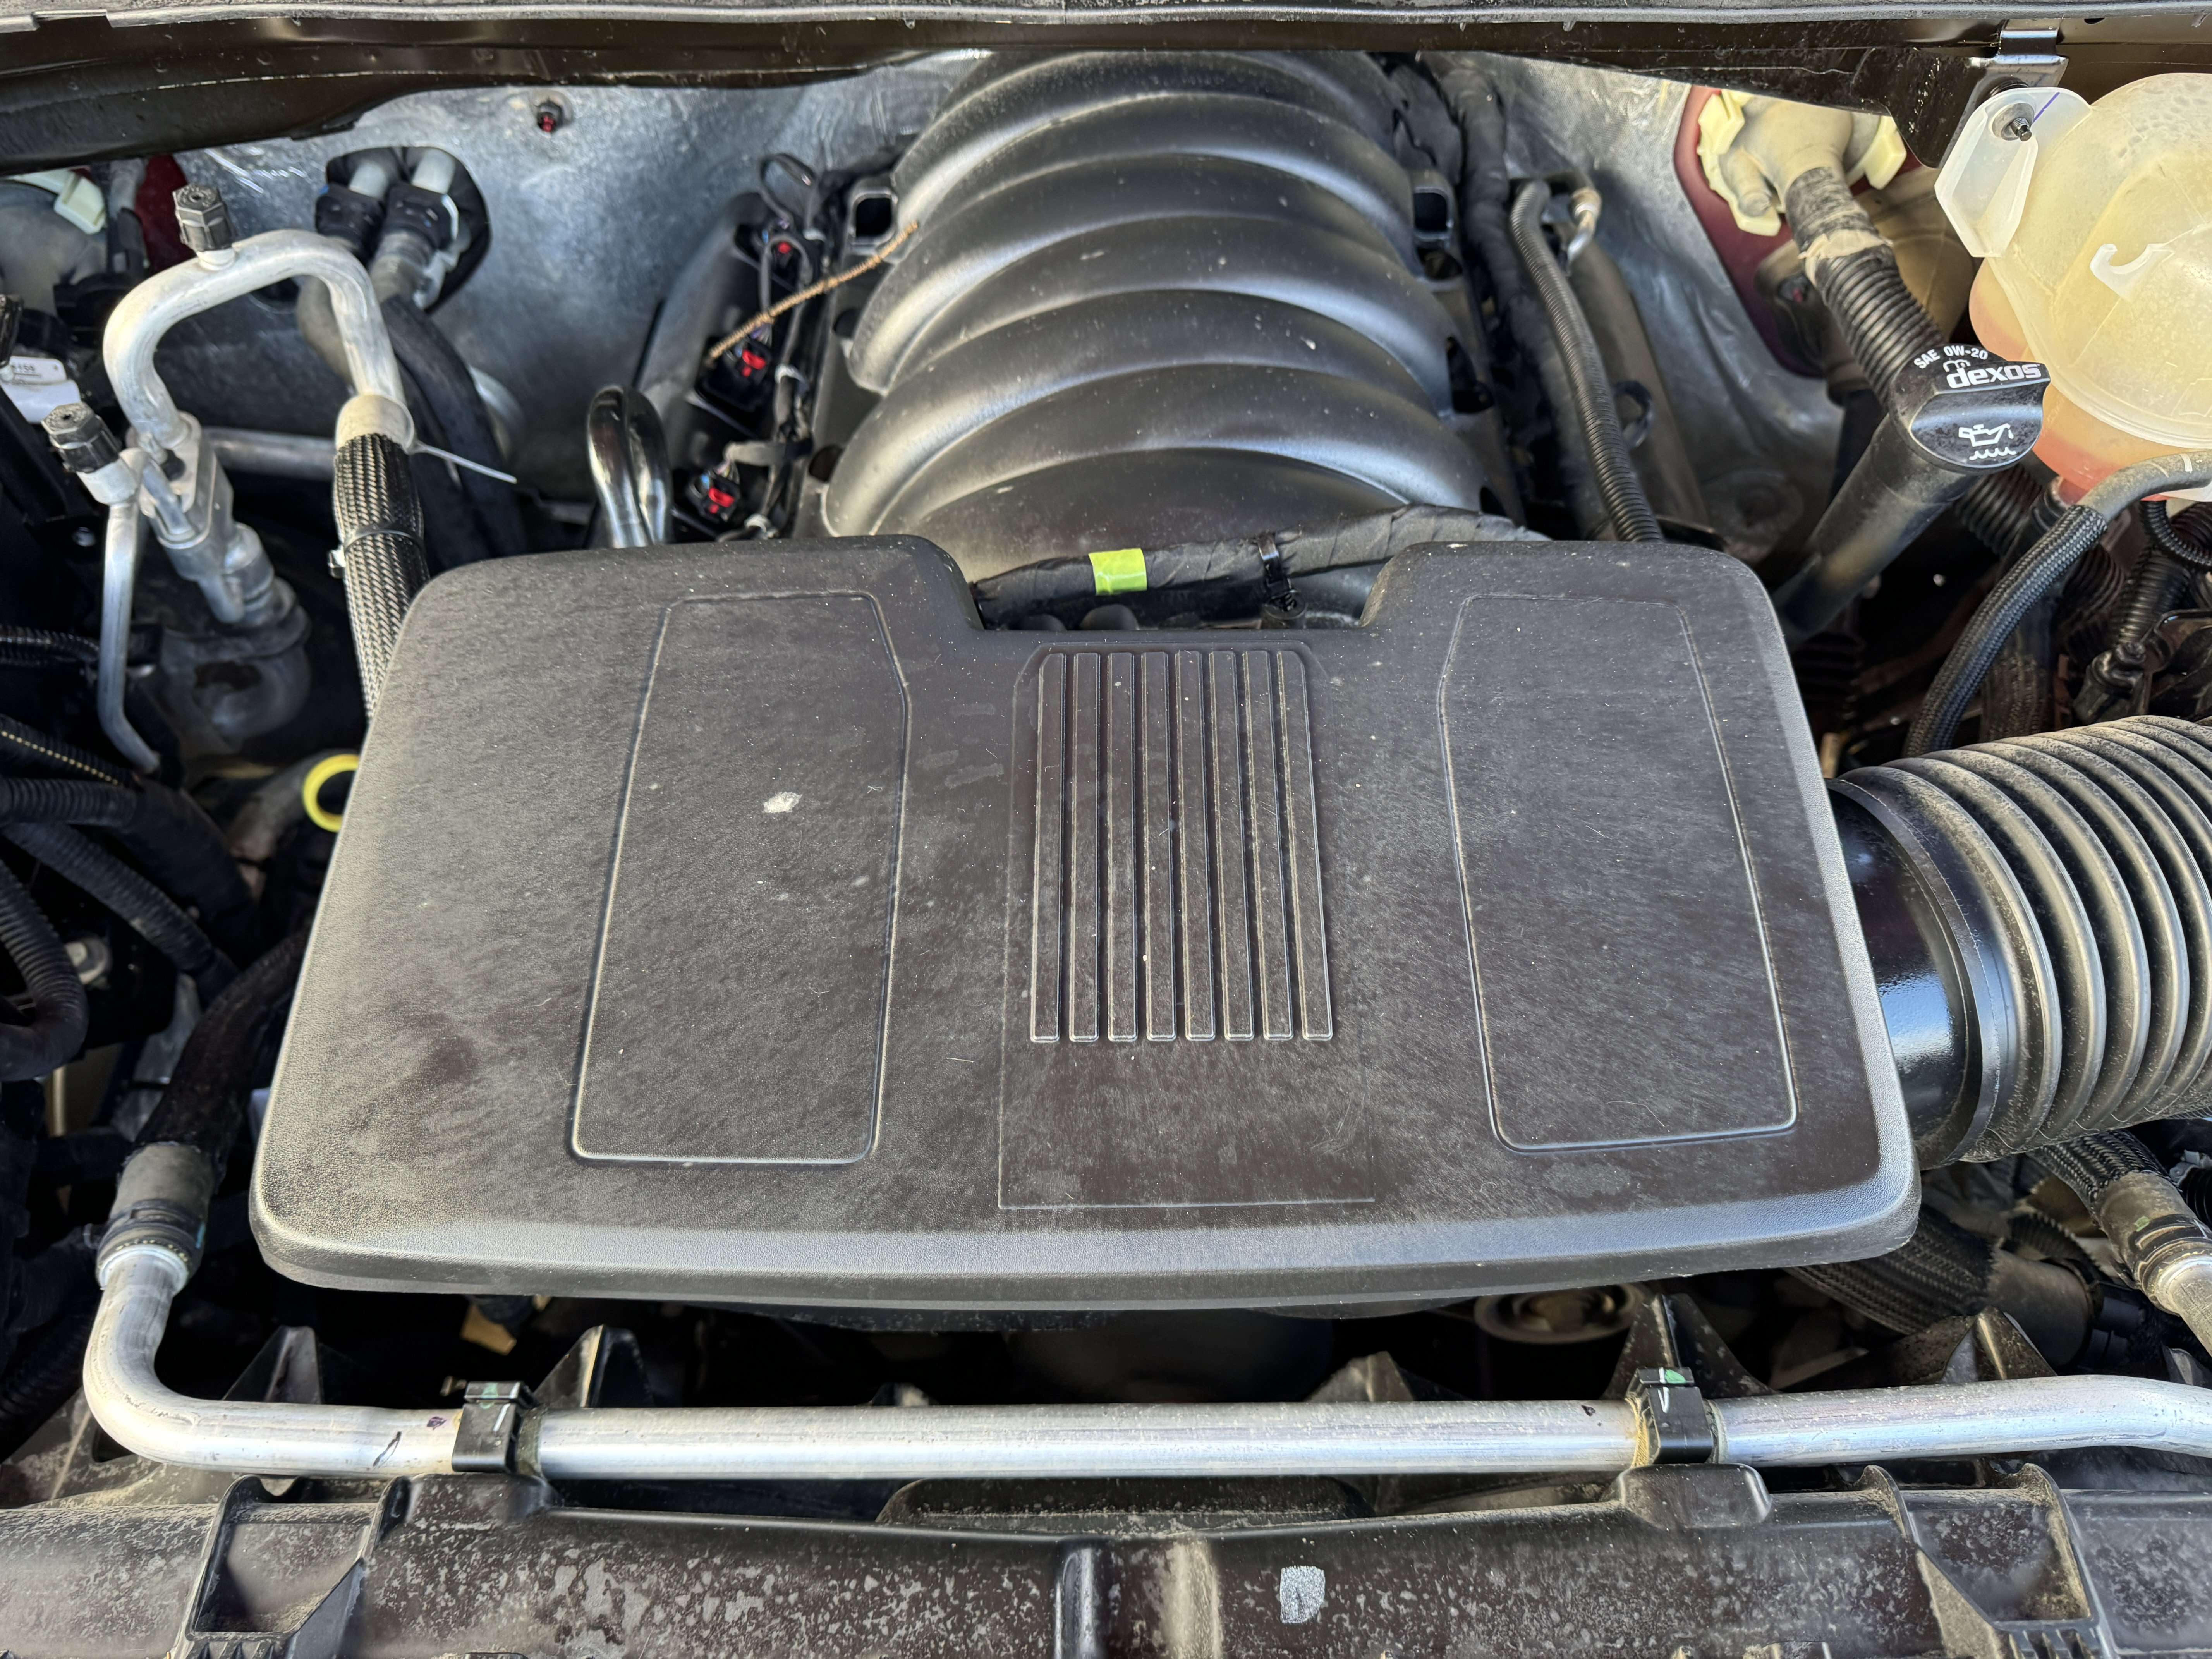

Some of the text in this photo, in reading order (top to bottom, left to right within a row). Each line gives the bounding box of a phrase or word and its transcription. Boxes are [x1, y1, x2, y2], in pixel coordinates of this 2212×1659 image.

[1914, 345, 1988, 368] SAE 0W-20
[1946, 364, 2041, 388] dexos
